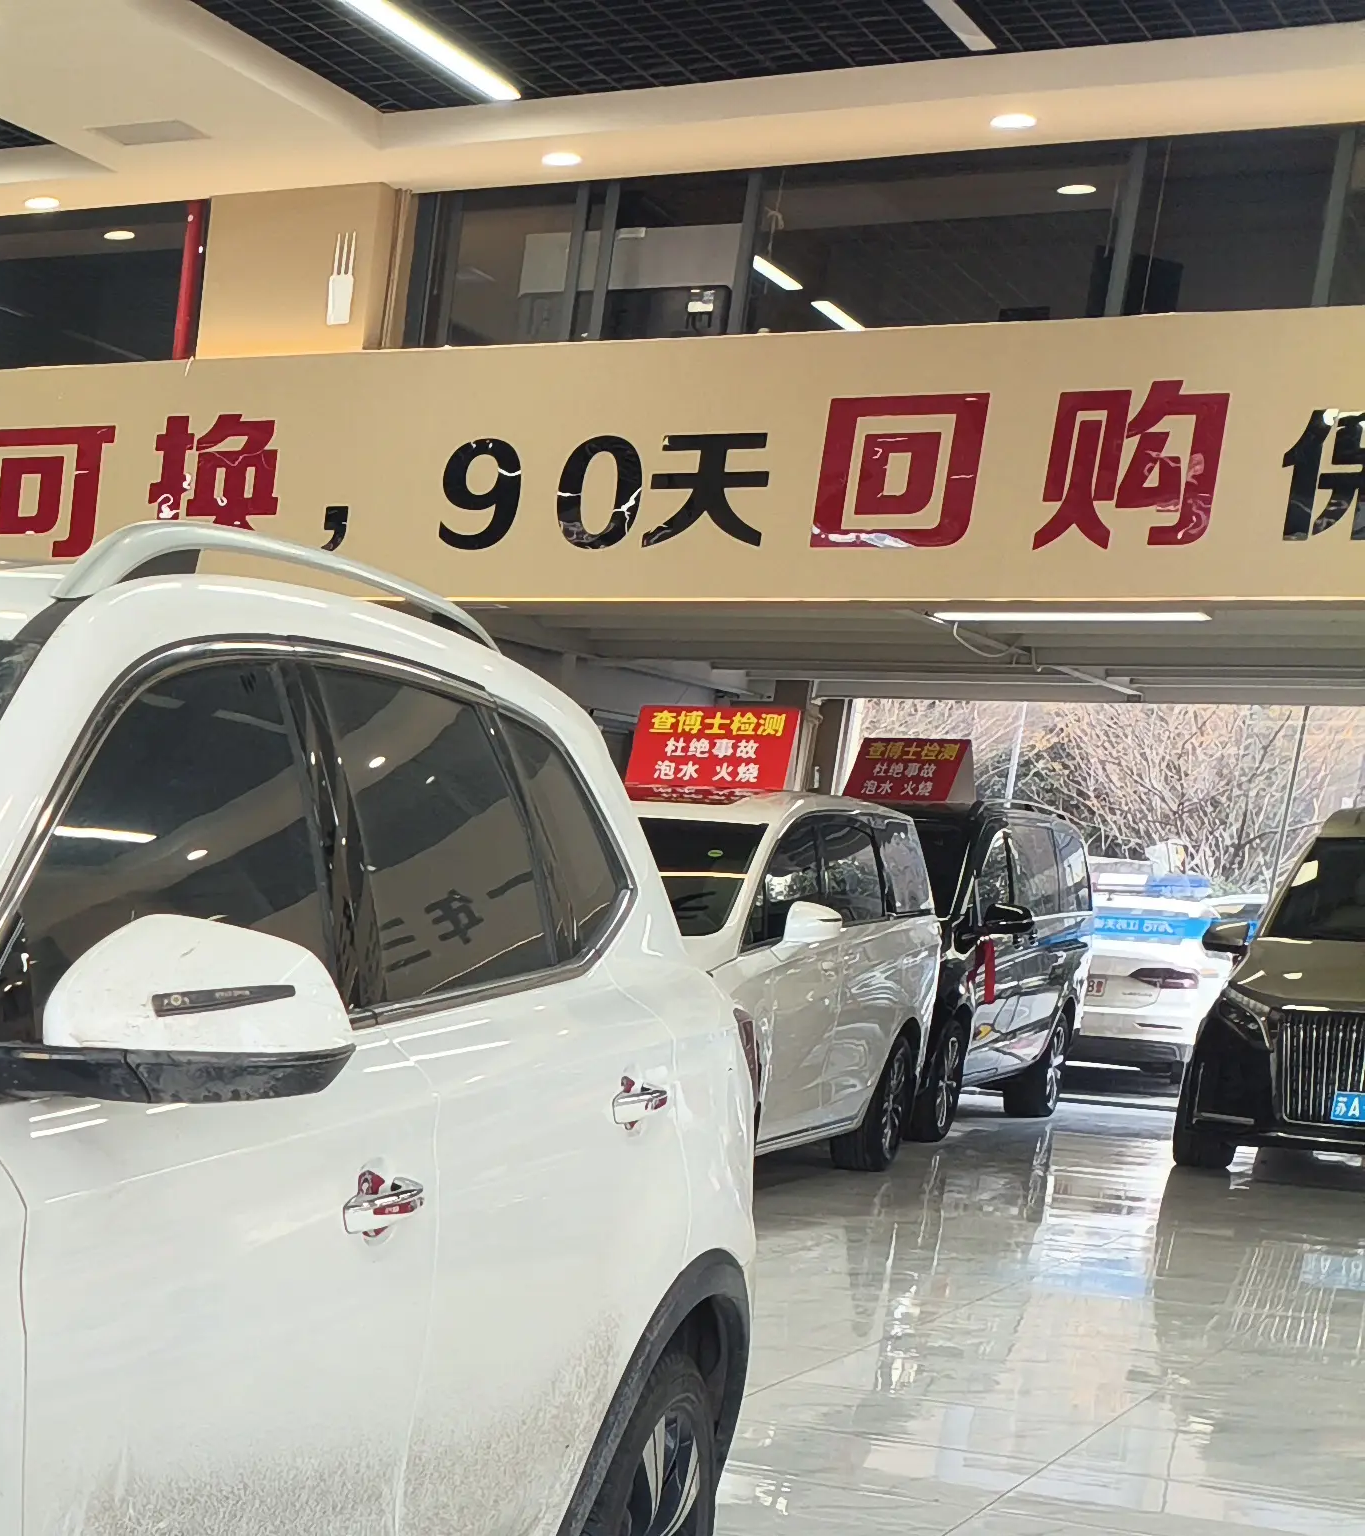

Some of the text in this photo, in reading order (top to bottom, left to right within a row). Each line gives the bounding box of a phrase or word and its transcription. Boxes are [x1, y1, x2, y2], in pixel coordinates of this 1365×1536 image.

[649, 710, 787, 738] 查博士检测
[665, 737, 760, 759] 杜绝事故
[865, 742, 961, 762] 查博士检测
[654, 760, 760, 783] 泡水 火烧
[872, 761, 937, 778] 杜绝事故
[861, 779, 933, 797] 泡水 火烧
